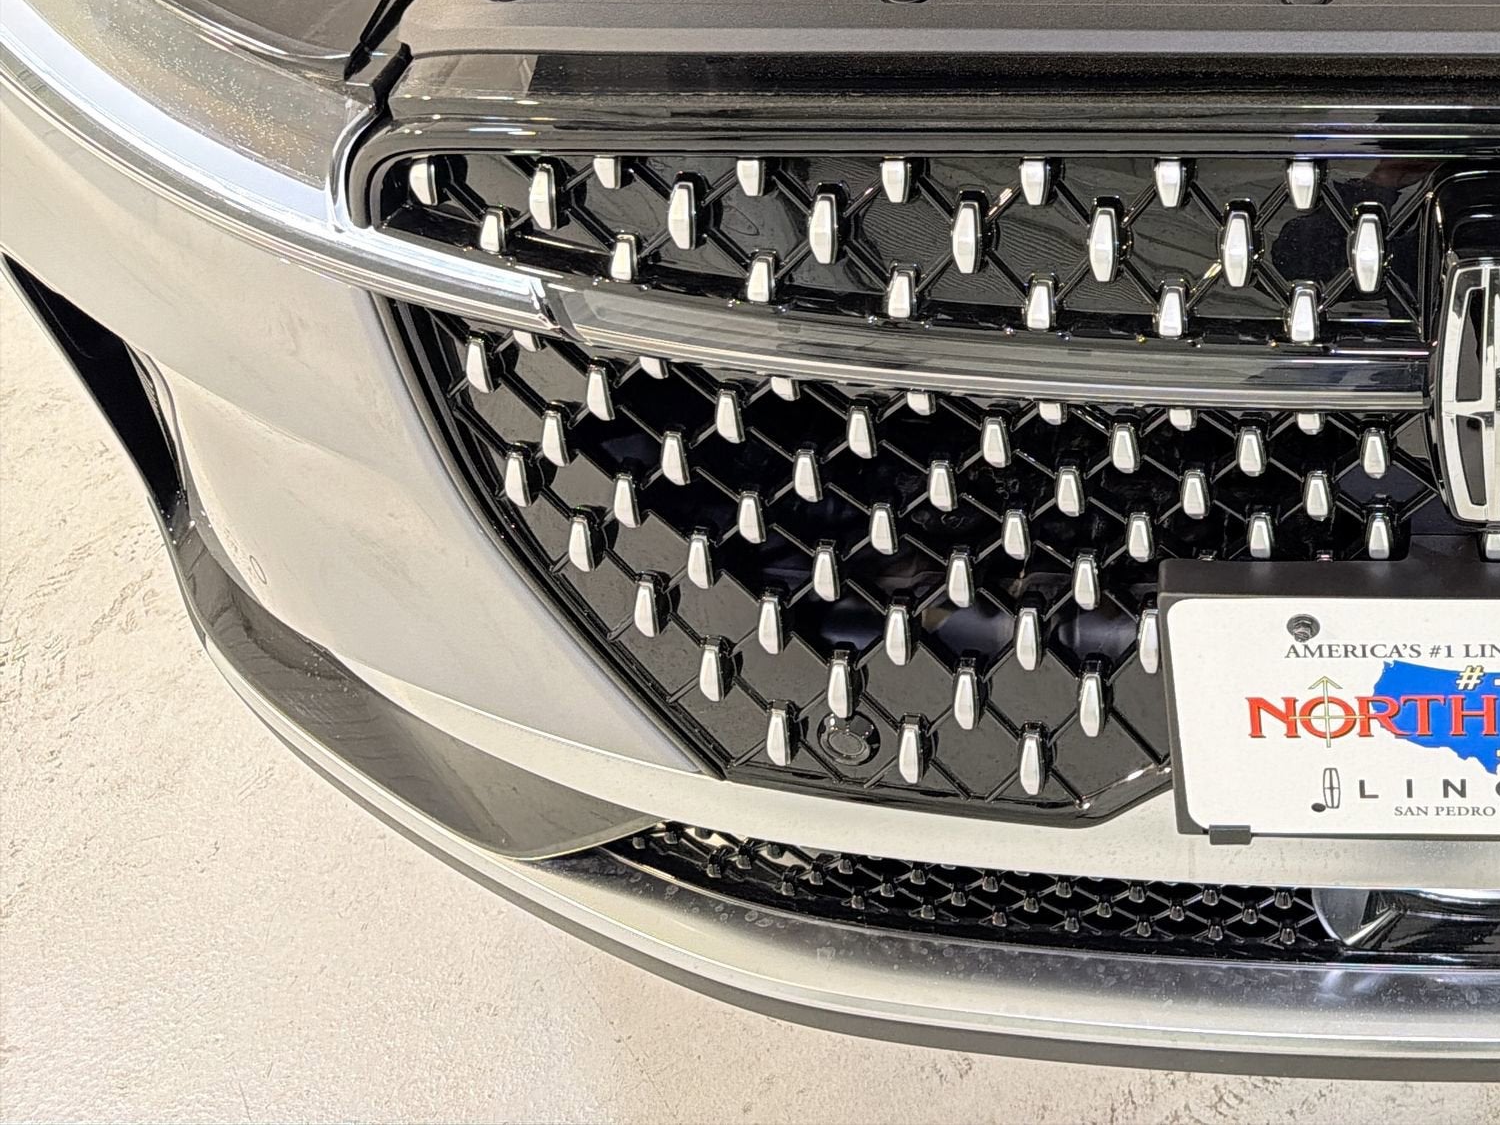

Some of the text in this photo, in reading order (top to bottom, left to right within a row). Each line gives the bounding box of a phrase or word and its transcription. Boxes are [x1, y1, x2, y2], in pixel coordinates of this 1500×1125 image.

[1284, 643, 1422, 659] AMERICA'S
[1429, 644, 1455, 659] #1
[1245, 694, 1498, 739] NORTH
[1394, 806, 1429, 817] SAN
[1434, 806, 1496, 817] PEDRO
